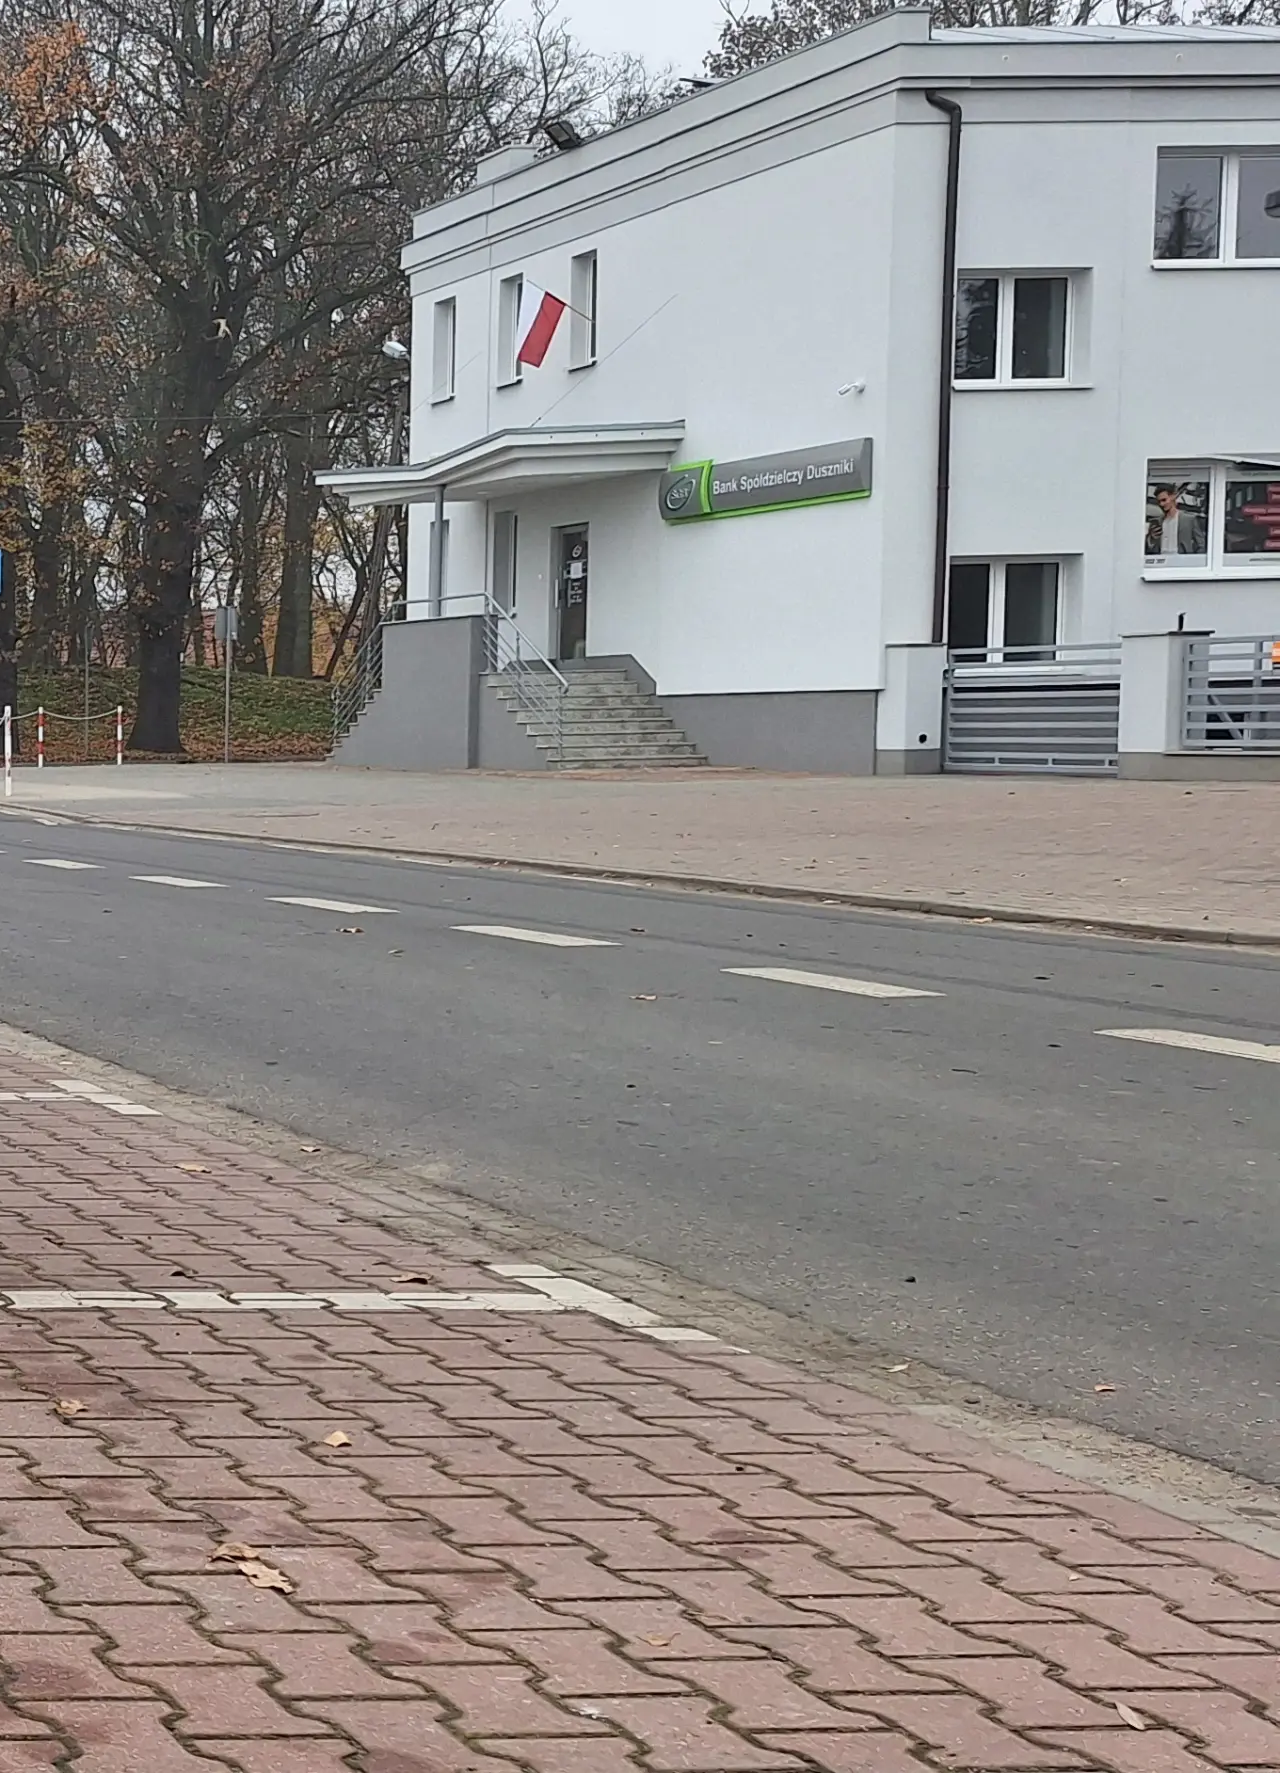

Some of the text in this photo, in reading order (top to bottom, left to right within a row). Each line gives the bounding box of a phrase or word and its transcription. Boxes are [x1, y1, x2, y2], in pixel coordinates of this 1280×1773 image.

[712, 458, 855, 496] Bank Spółdzielczy Duszniki
